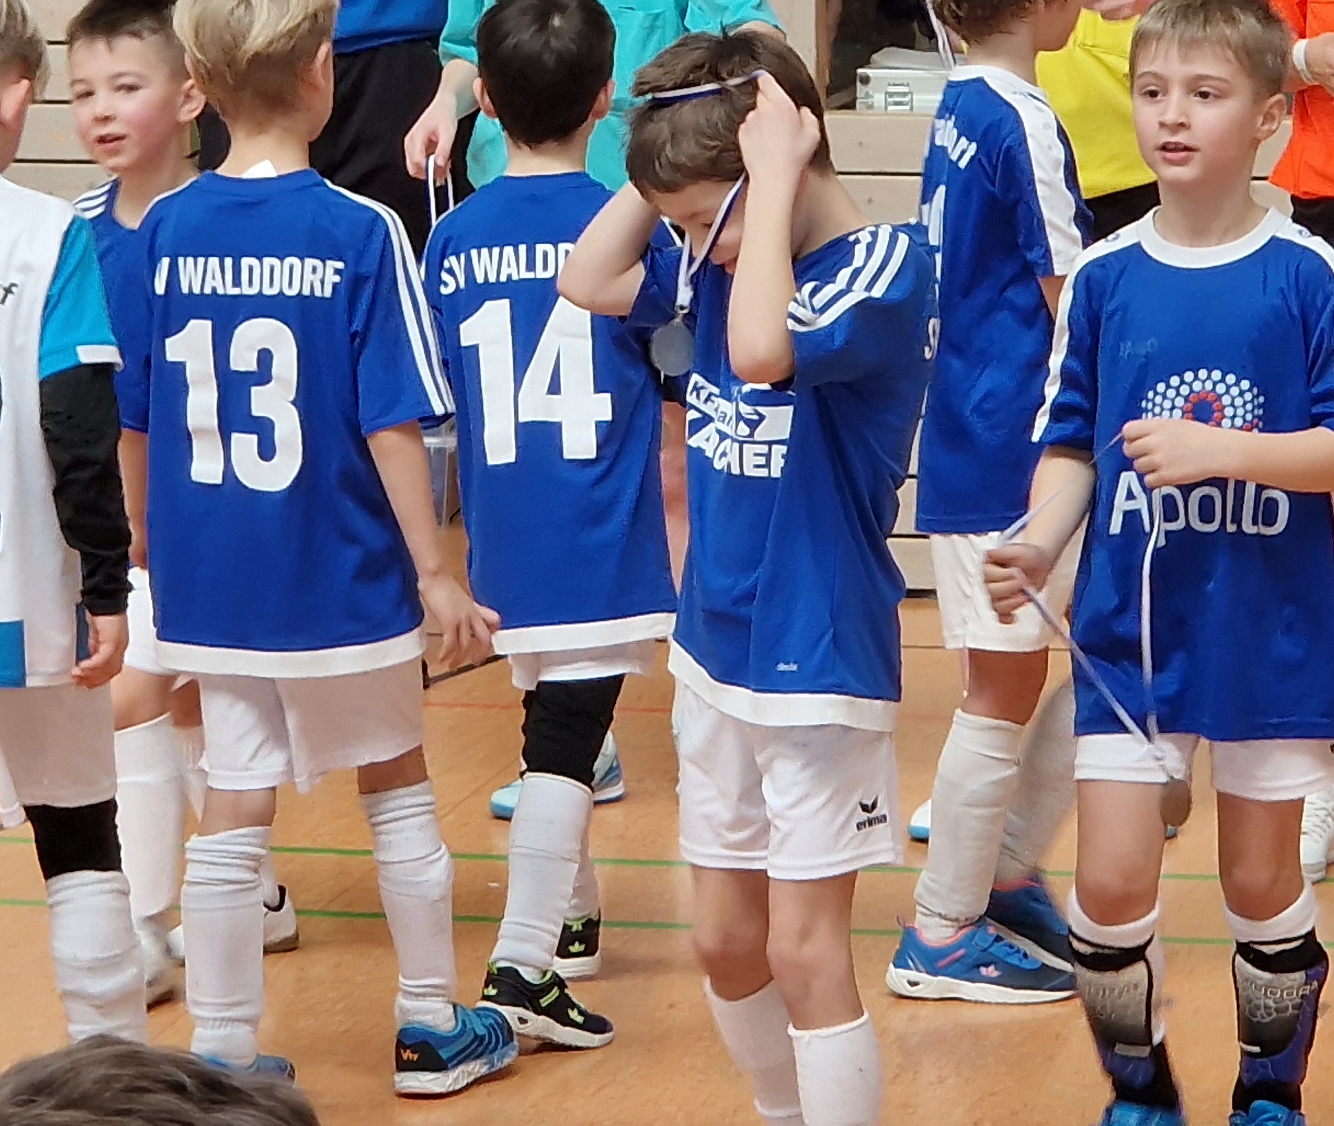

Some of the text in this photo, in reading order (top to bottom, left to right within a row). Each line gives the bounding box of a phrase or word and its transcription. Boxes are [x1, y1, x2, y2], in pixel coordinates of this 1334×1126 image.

[177, 256, 345, 298] WALDDORF
[439, 242, 576, 295] SV WALDD
[165, 317, 303, 492] 13
[459, 295, 613, 466] 14
[1108, 470, 1290, 549] Apollo
[856, 813, 888, 832] erima
